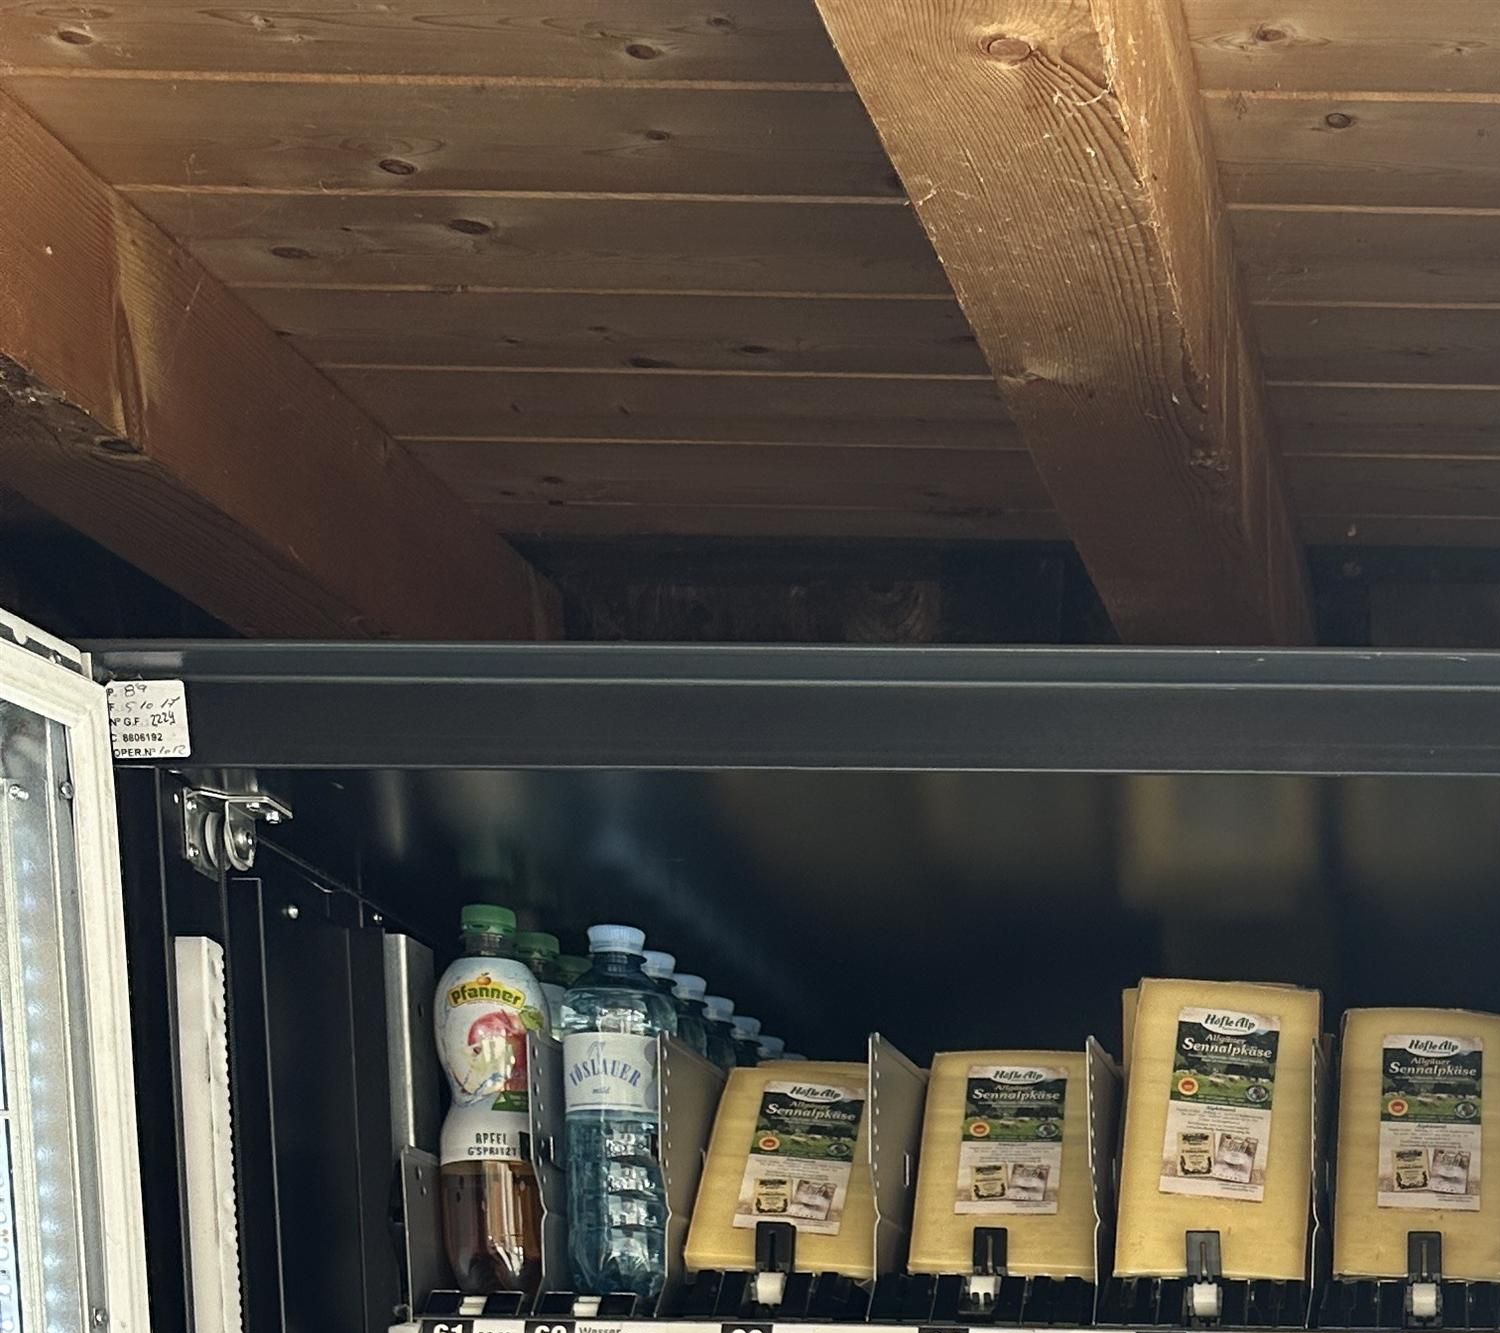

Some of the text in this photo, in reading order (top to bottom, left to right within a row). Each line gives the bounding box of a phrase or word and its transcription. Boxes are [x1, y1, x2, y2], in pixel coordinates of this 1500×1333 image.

[1182, 1037, 1272, 1058] Sennalpkäse
[1389, 1062, 1476, 1077] Sennalpkäse
[972, 1089, 1060, 1101] Sennalpkäse
[766, 1102, 856, 1120] Sennalpkäse
